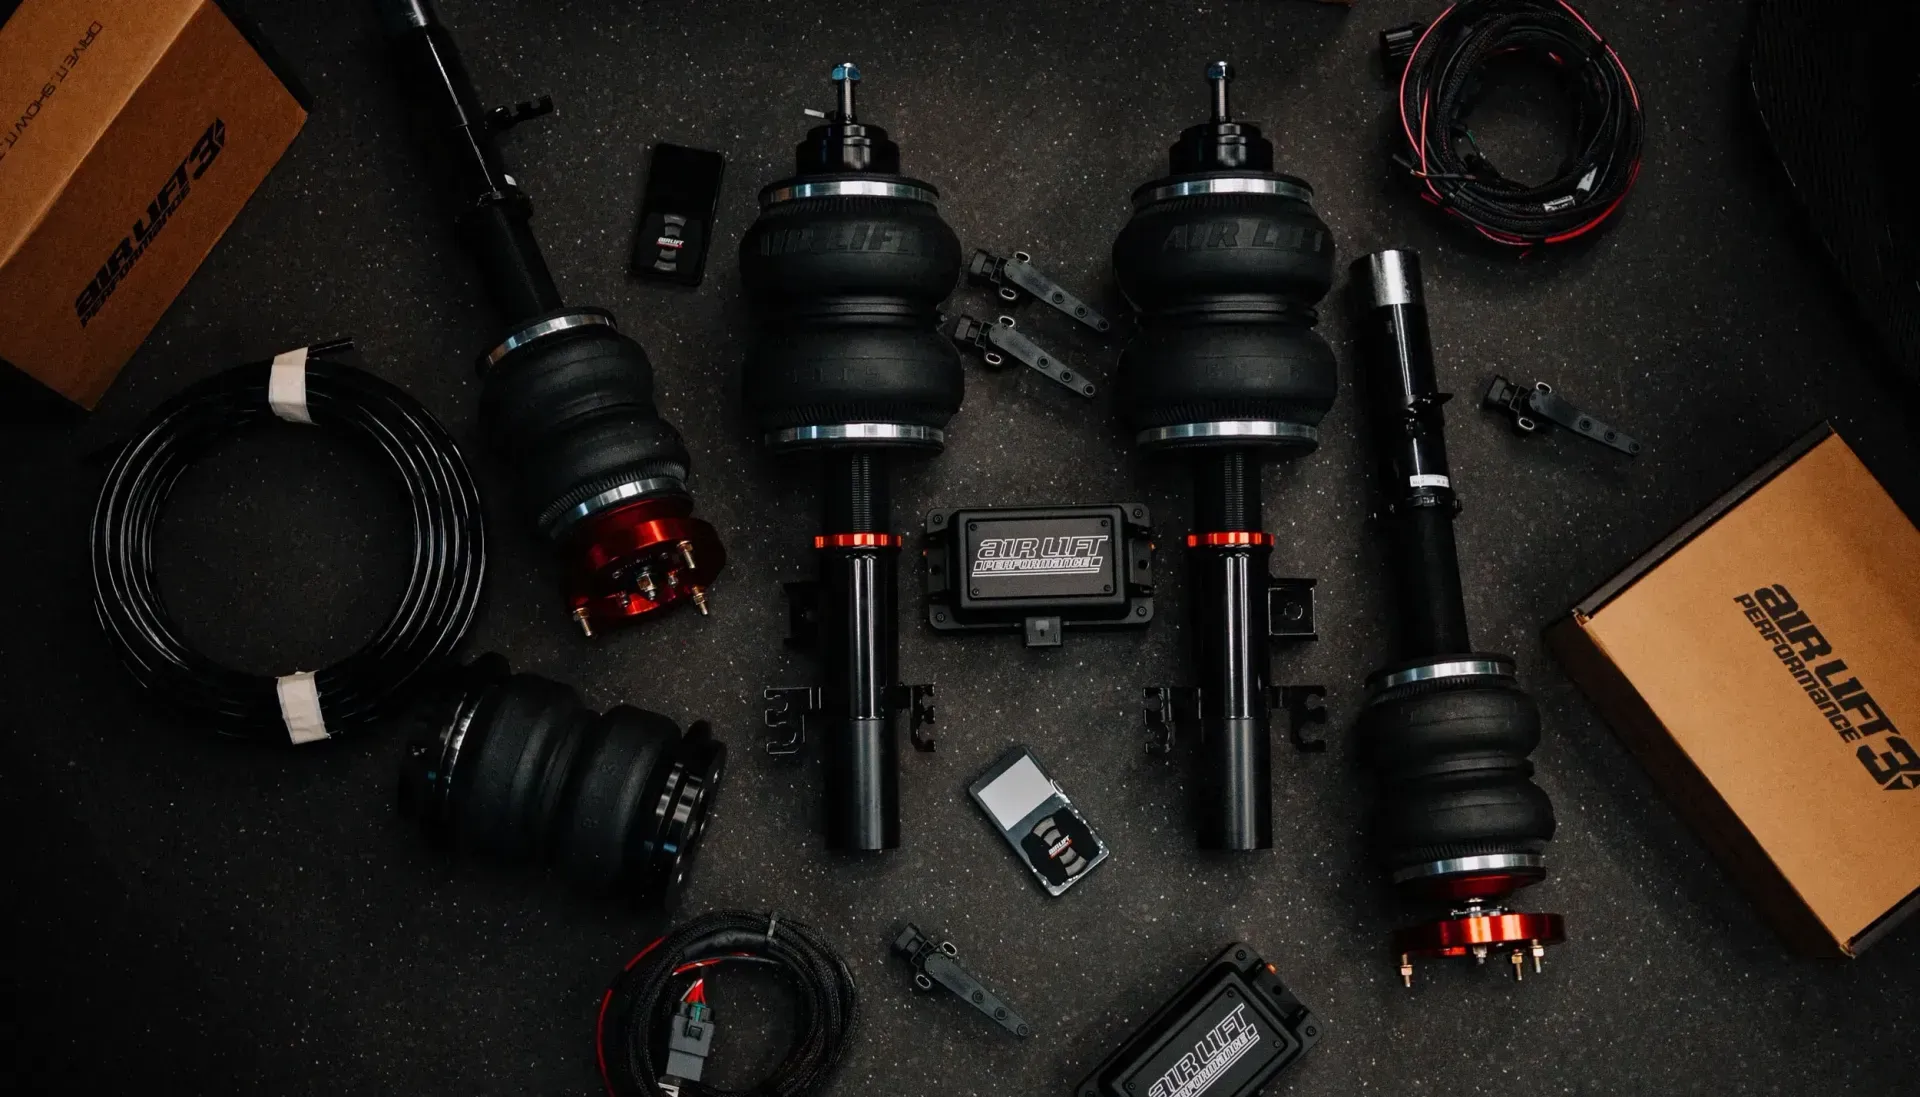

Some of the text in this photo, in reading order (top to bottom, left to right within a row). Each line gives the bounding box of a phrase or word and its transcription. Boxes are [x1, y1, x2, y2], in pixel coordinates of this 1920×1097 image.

[63, 21, 103, 68] DRIVE
[15, 82, 56, 134] SHOW
[1162, 221, 1239, 252] AIR
[1041, 535, 1109, 557] LIFT
[1814, 658, 1901, 737] LIFT
[1195, 1003, 1246, 1065] LIFT
